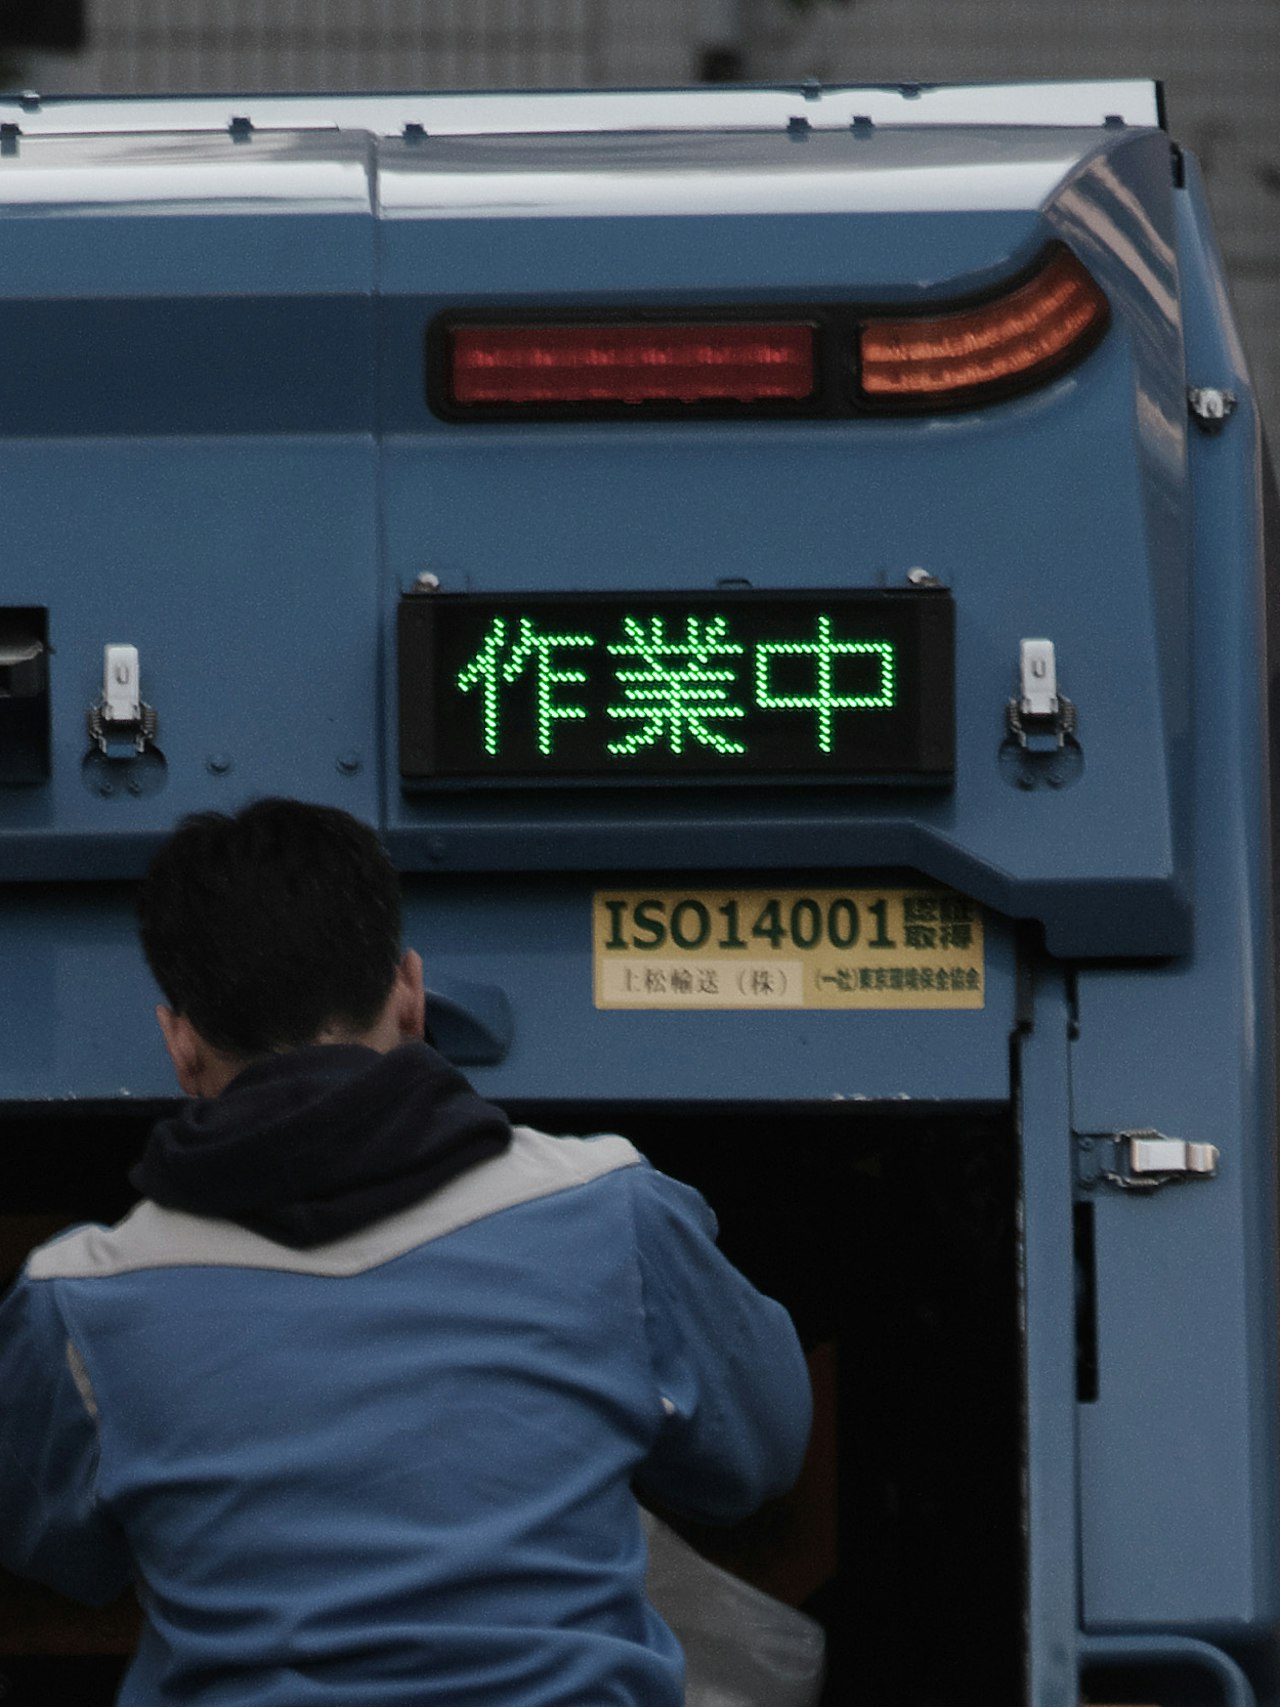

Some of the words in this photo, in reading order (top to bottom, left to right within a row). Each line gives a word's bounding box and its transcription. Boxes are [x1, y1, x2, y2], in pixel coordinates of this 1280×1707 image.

[457, 615, 895, 755] 作業中
[604, 899, 896, 950] ISO14001
